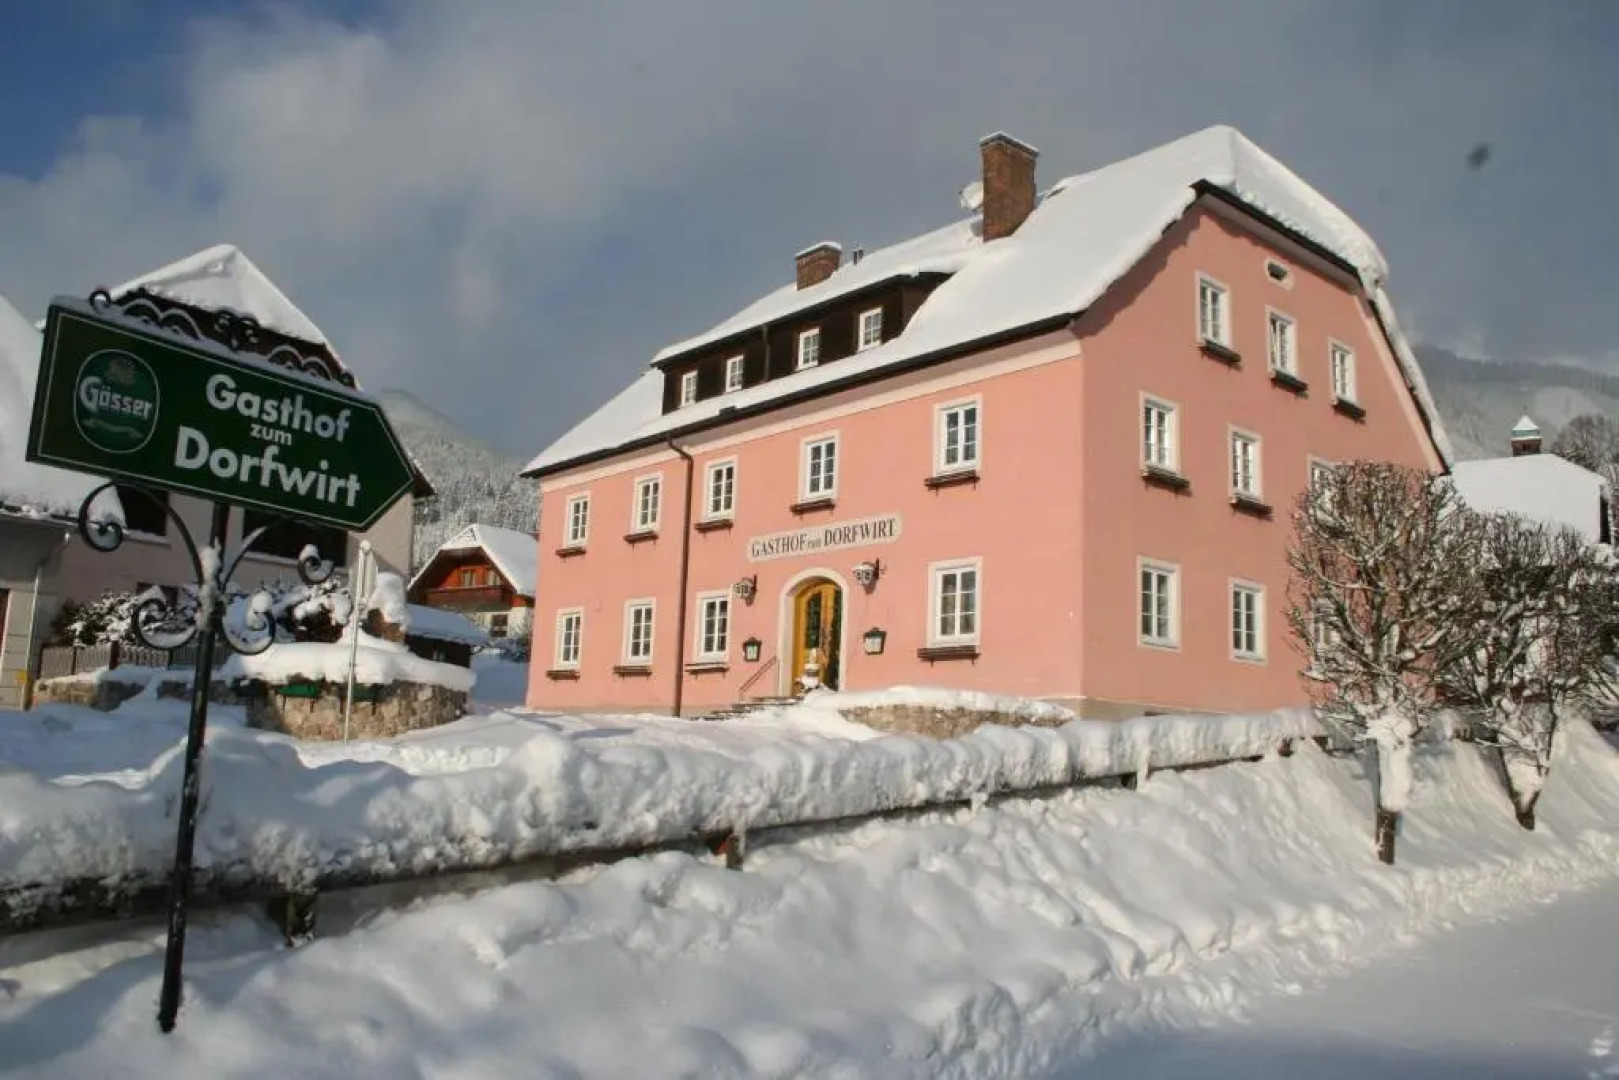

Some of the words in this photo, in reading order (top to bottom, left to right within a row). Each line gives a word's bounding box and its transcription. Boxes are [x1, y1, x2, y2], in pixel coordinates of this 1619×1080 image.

[80, 375, 153, 419] Gösser
[206, 374, 351, 441] Gasthof
[250, 423, 293, 446] zum
[174, 425, 361, 507] Dorfwirt
[751, 532, 807, 557] GASTHOF
[824, 518, 896, 547] DORFWIRT
